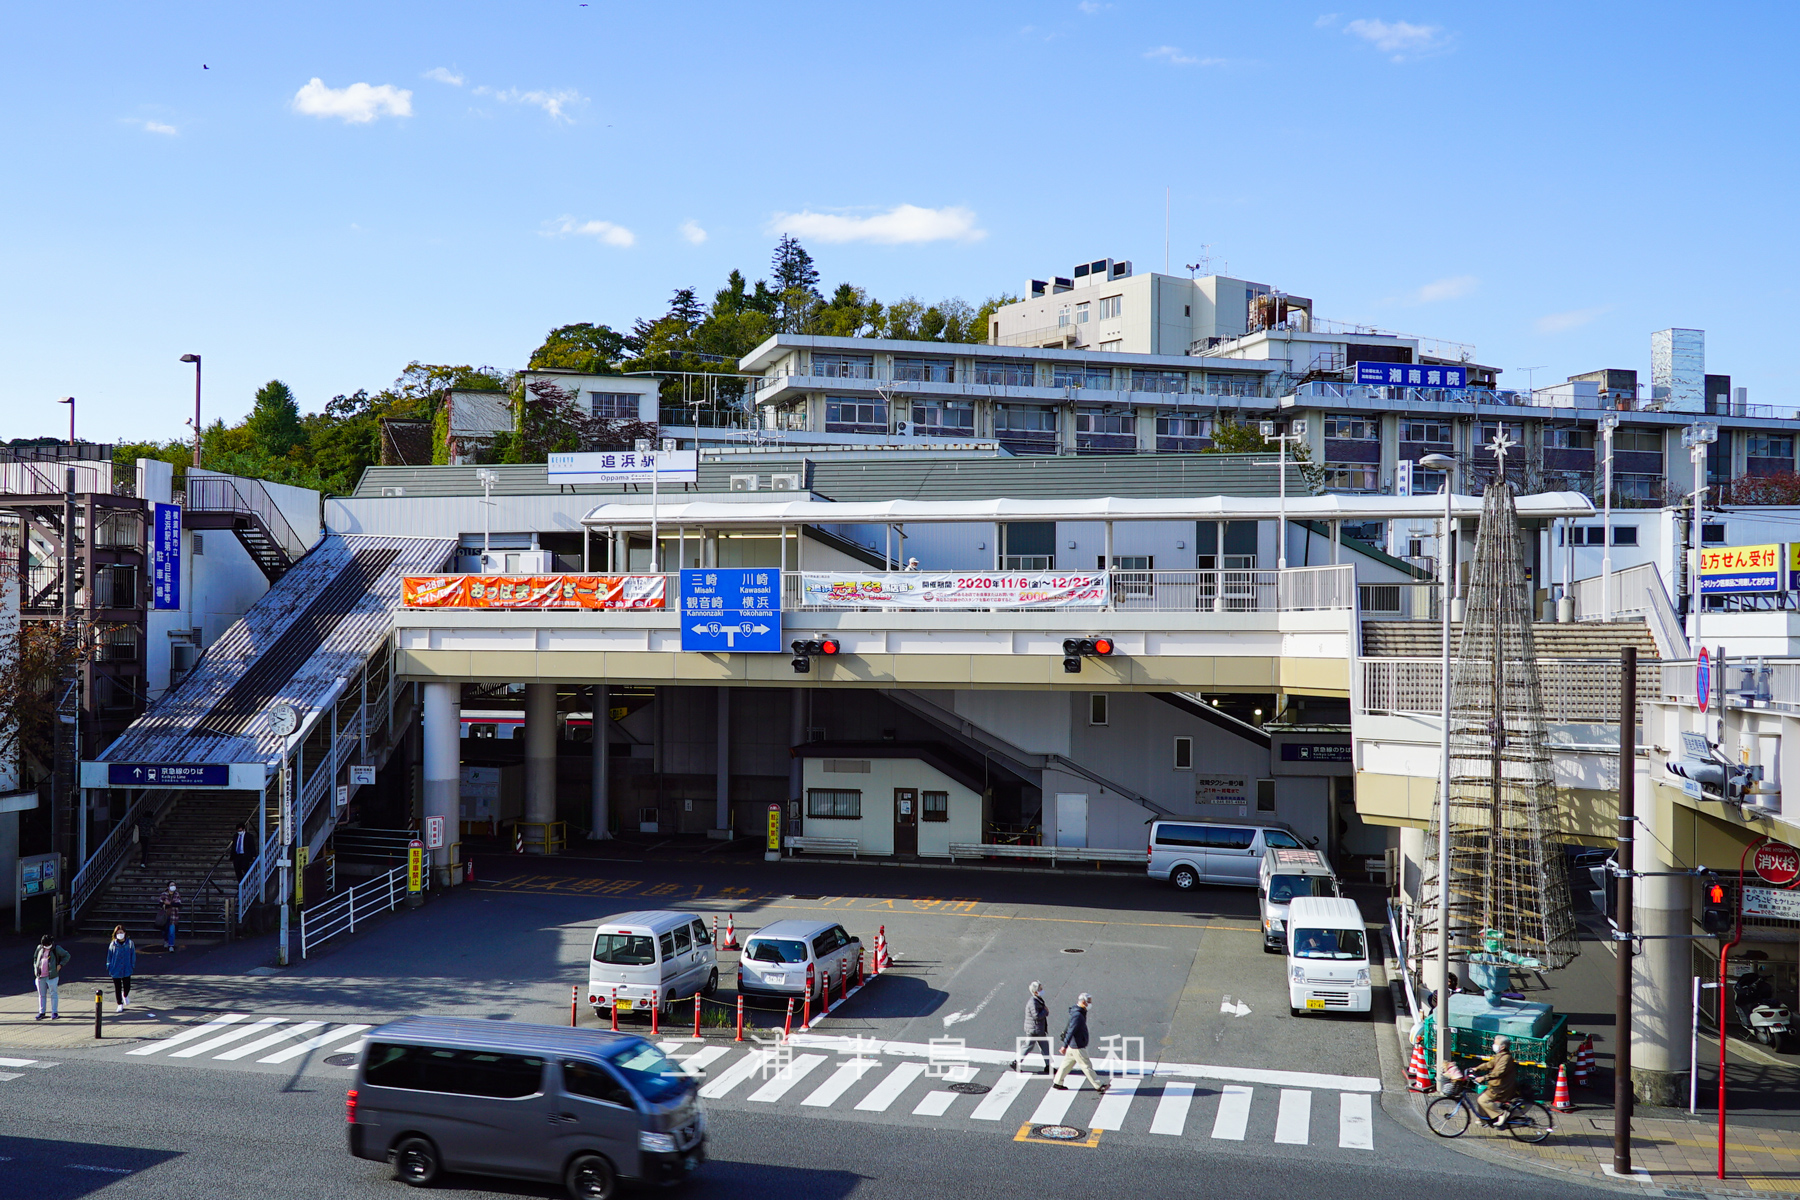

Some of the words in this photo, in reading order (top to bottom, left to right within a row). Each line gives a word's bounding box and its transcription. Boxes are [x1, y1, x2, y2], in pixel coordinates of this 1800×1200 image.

[1389, 367, 1460, 386] 湘南病院
[601, 454, 655, 469] 追浜駅
[691, 573, 718, 586] 三崎
[742, 573, 769, 586] 川崎
[694, 586, 716, 594] Misaki
[740, 586, 771, 594] Kawasaki
[686, 596, 723, 609] 観音崎
[742, 596, 769, 609] 横浜
[709, 624, 719, 633] 16
[742, 624, 752, 633] 16
[161, 767, 204, 775] 京急線のりば
[411, 850, 420, 886] 駐停車禁止
[1758, 853, 1797, 872] 消火栓
